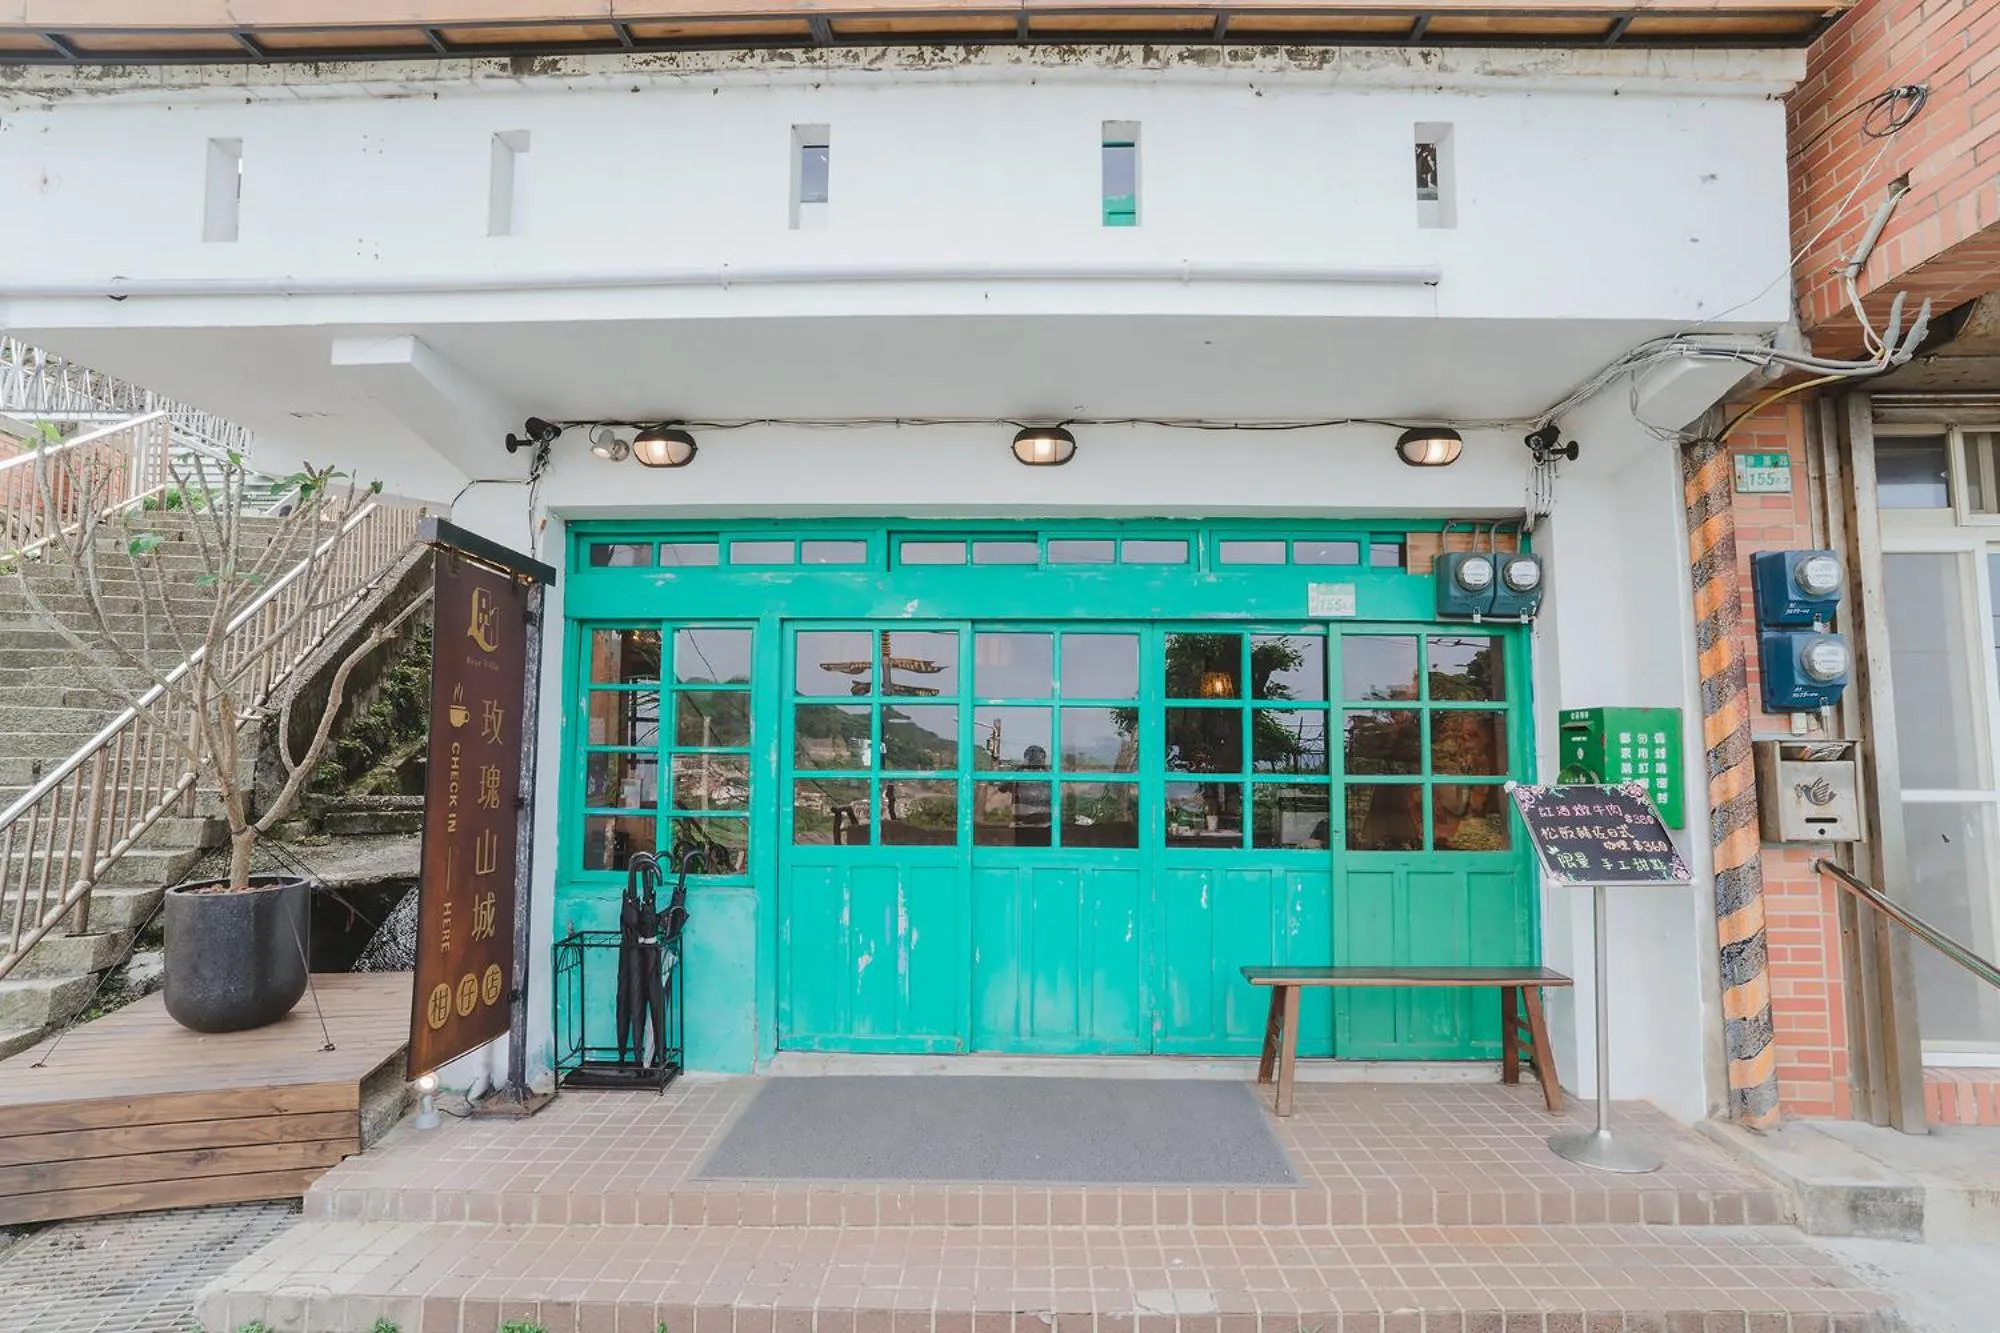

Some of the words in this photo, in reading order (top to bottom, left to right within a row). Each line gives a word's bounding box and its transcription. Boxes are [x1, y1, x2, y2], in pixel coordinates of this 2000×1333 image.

[449, 742, 460, 809] CHECK
[447, 813, 457, 833] IN
[472, 699, 506, 942] 玫瑰山城
[1557, 851, 1591, 869] 限量
[440, 902, 452, 952] HERE
[429, 967, 501, 1026] 柑仔店
